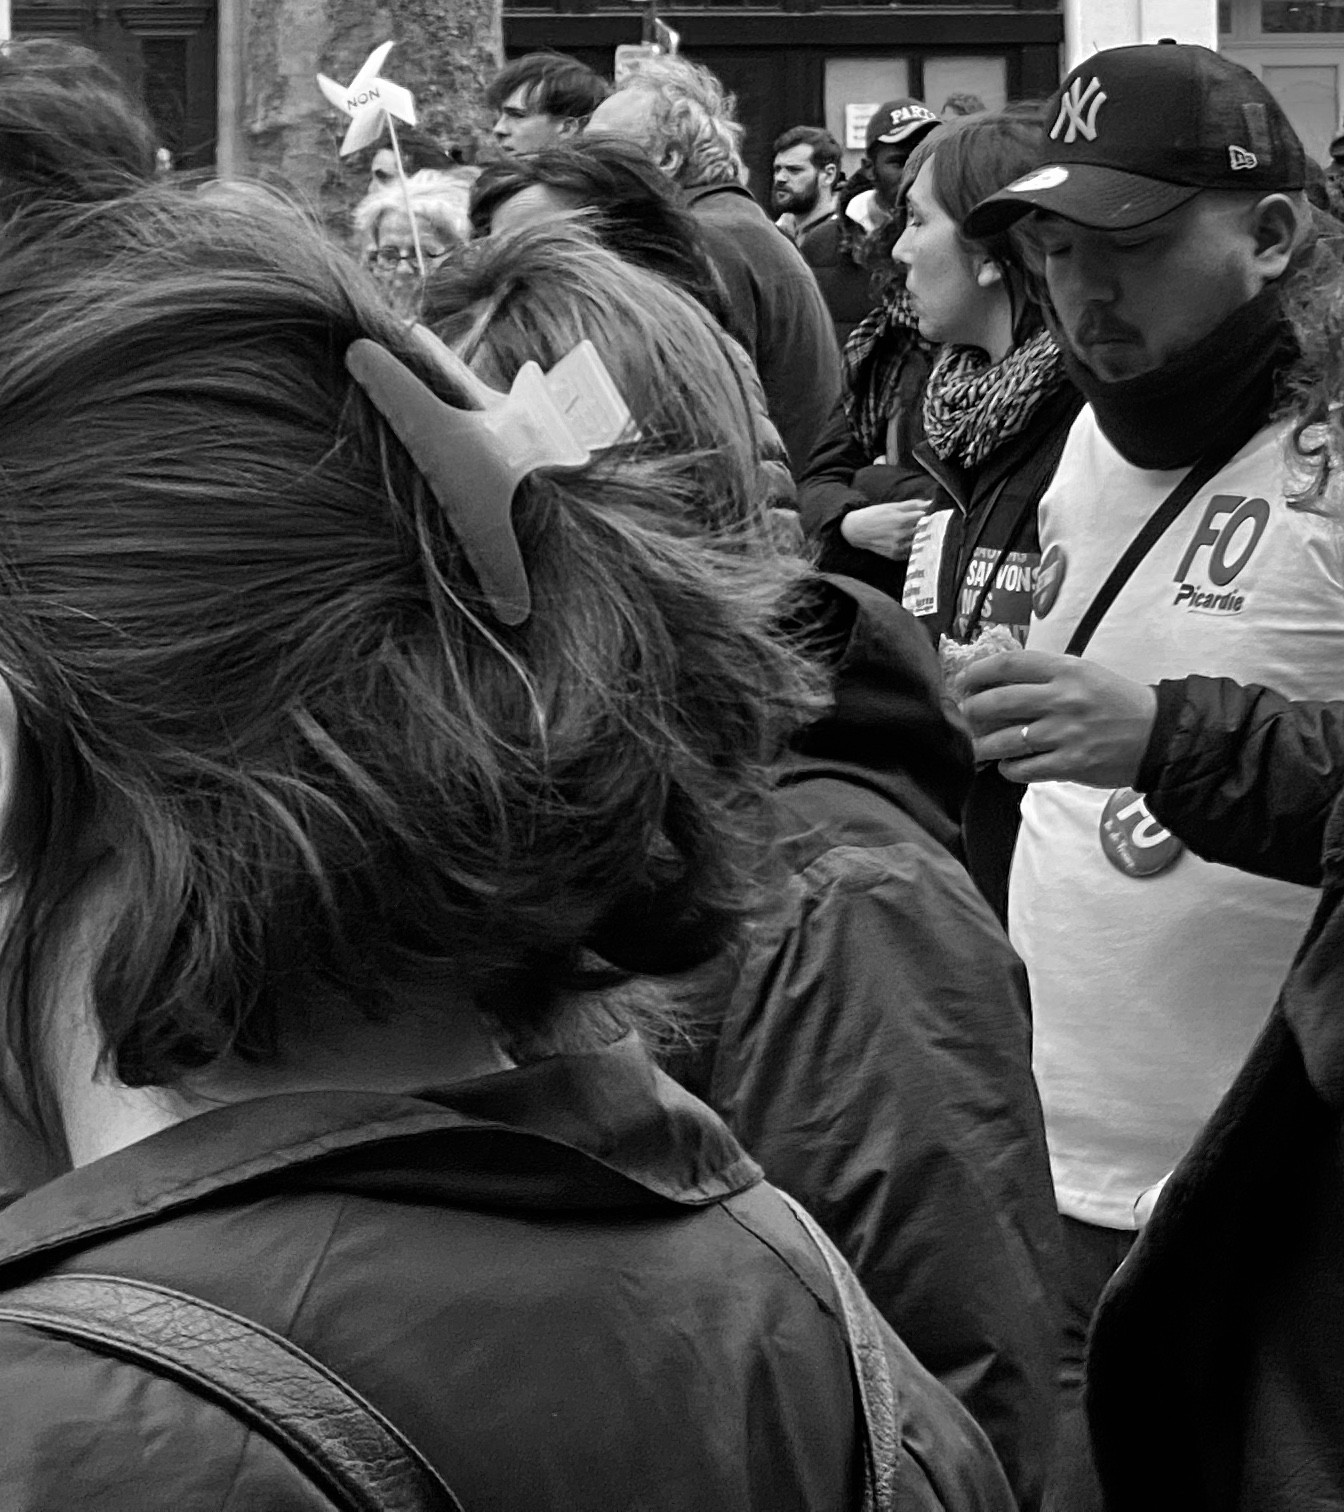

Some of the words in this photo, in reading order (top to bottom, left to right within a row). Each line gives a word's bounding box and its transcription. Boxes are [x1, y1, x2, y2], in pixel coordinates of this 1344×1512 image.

[346, 87, 381, 110] NON
[1049, 76, 1108, 144] NY
[1173, 494, 1271, 587] FO
[1173, 583, 1246, 612] Picardie
